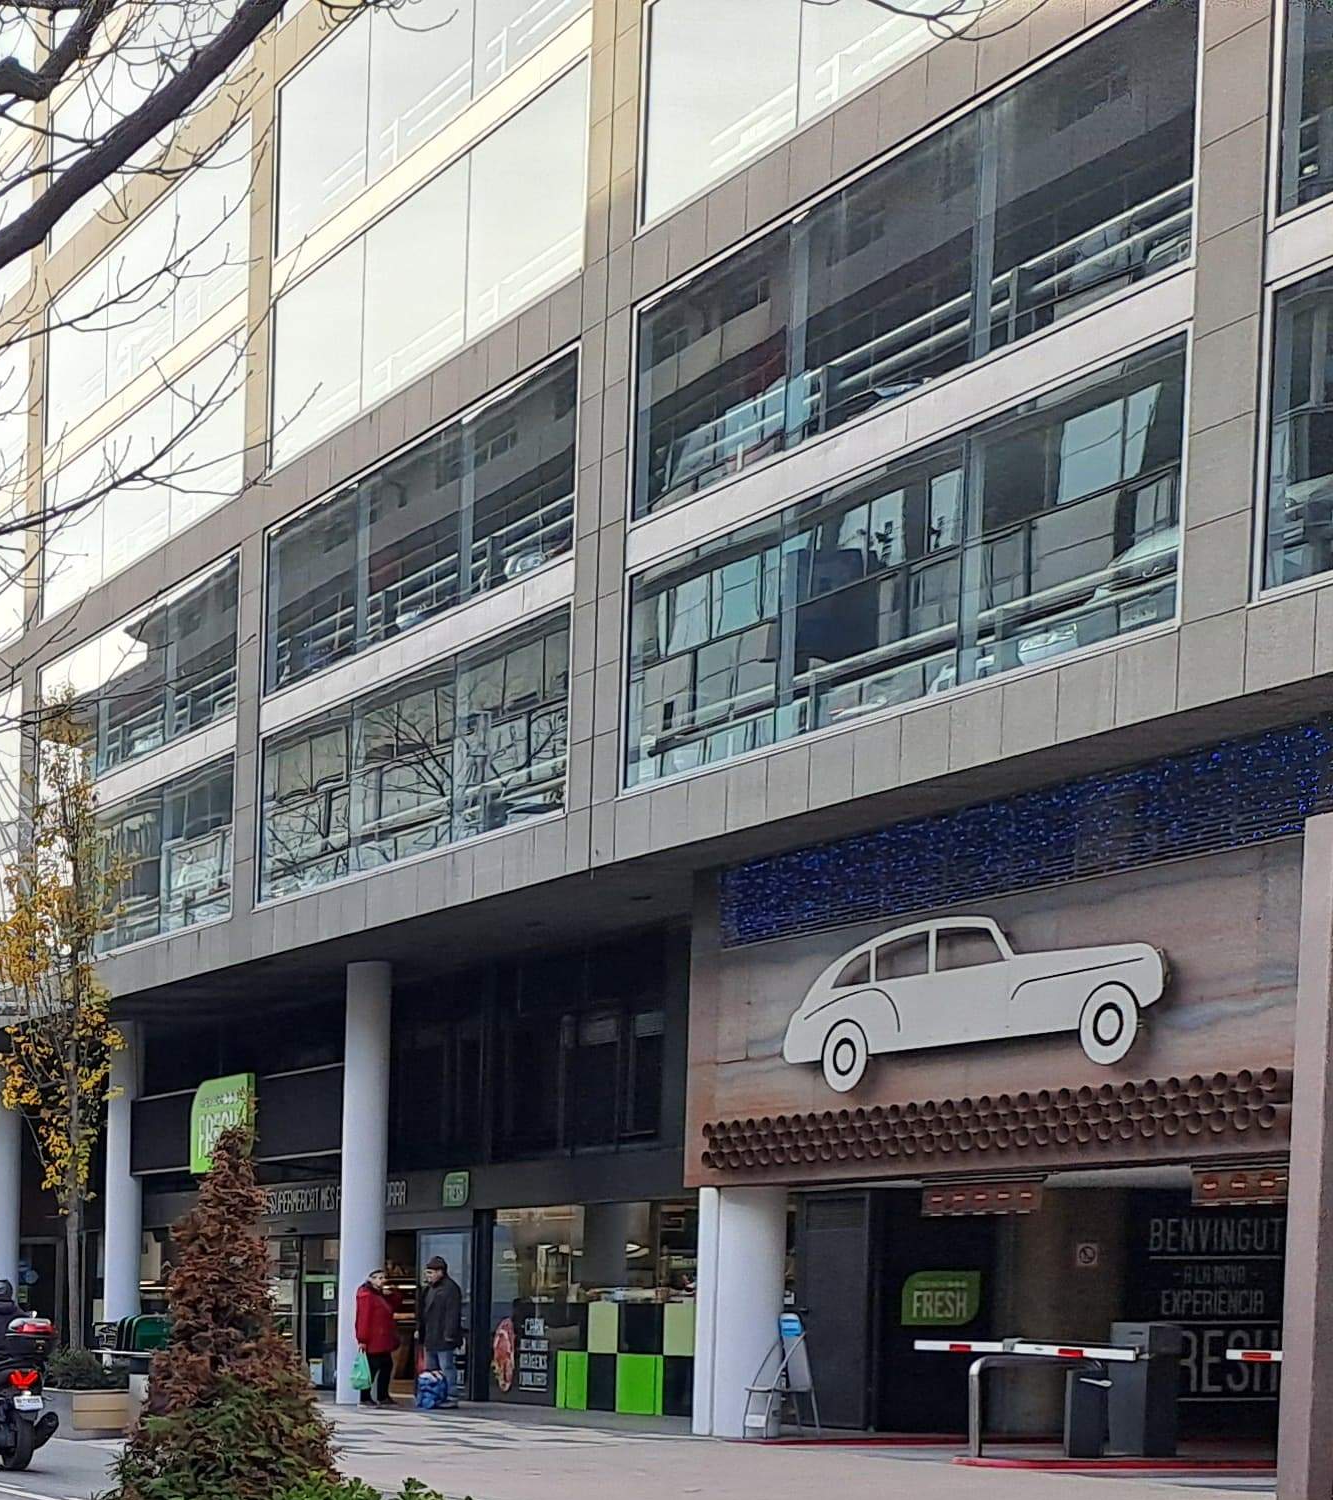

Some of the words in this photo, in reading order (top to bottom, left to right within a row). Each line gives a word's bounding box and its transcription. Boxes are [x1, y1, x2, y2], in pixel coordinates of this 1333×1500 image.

[1149, 1217, 1283, 1252] BENVINGUT
[913, 1290, 967, 1318] FRESH
[1179, 1329, 1278, 1393] RESH
